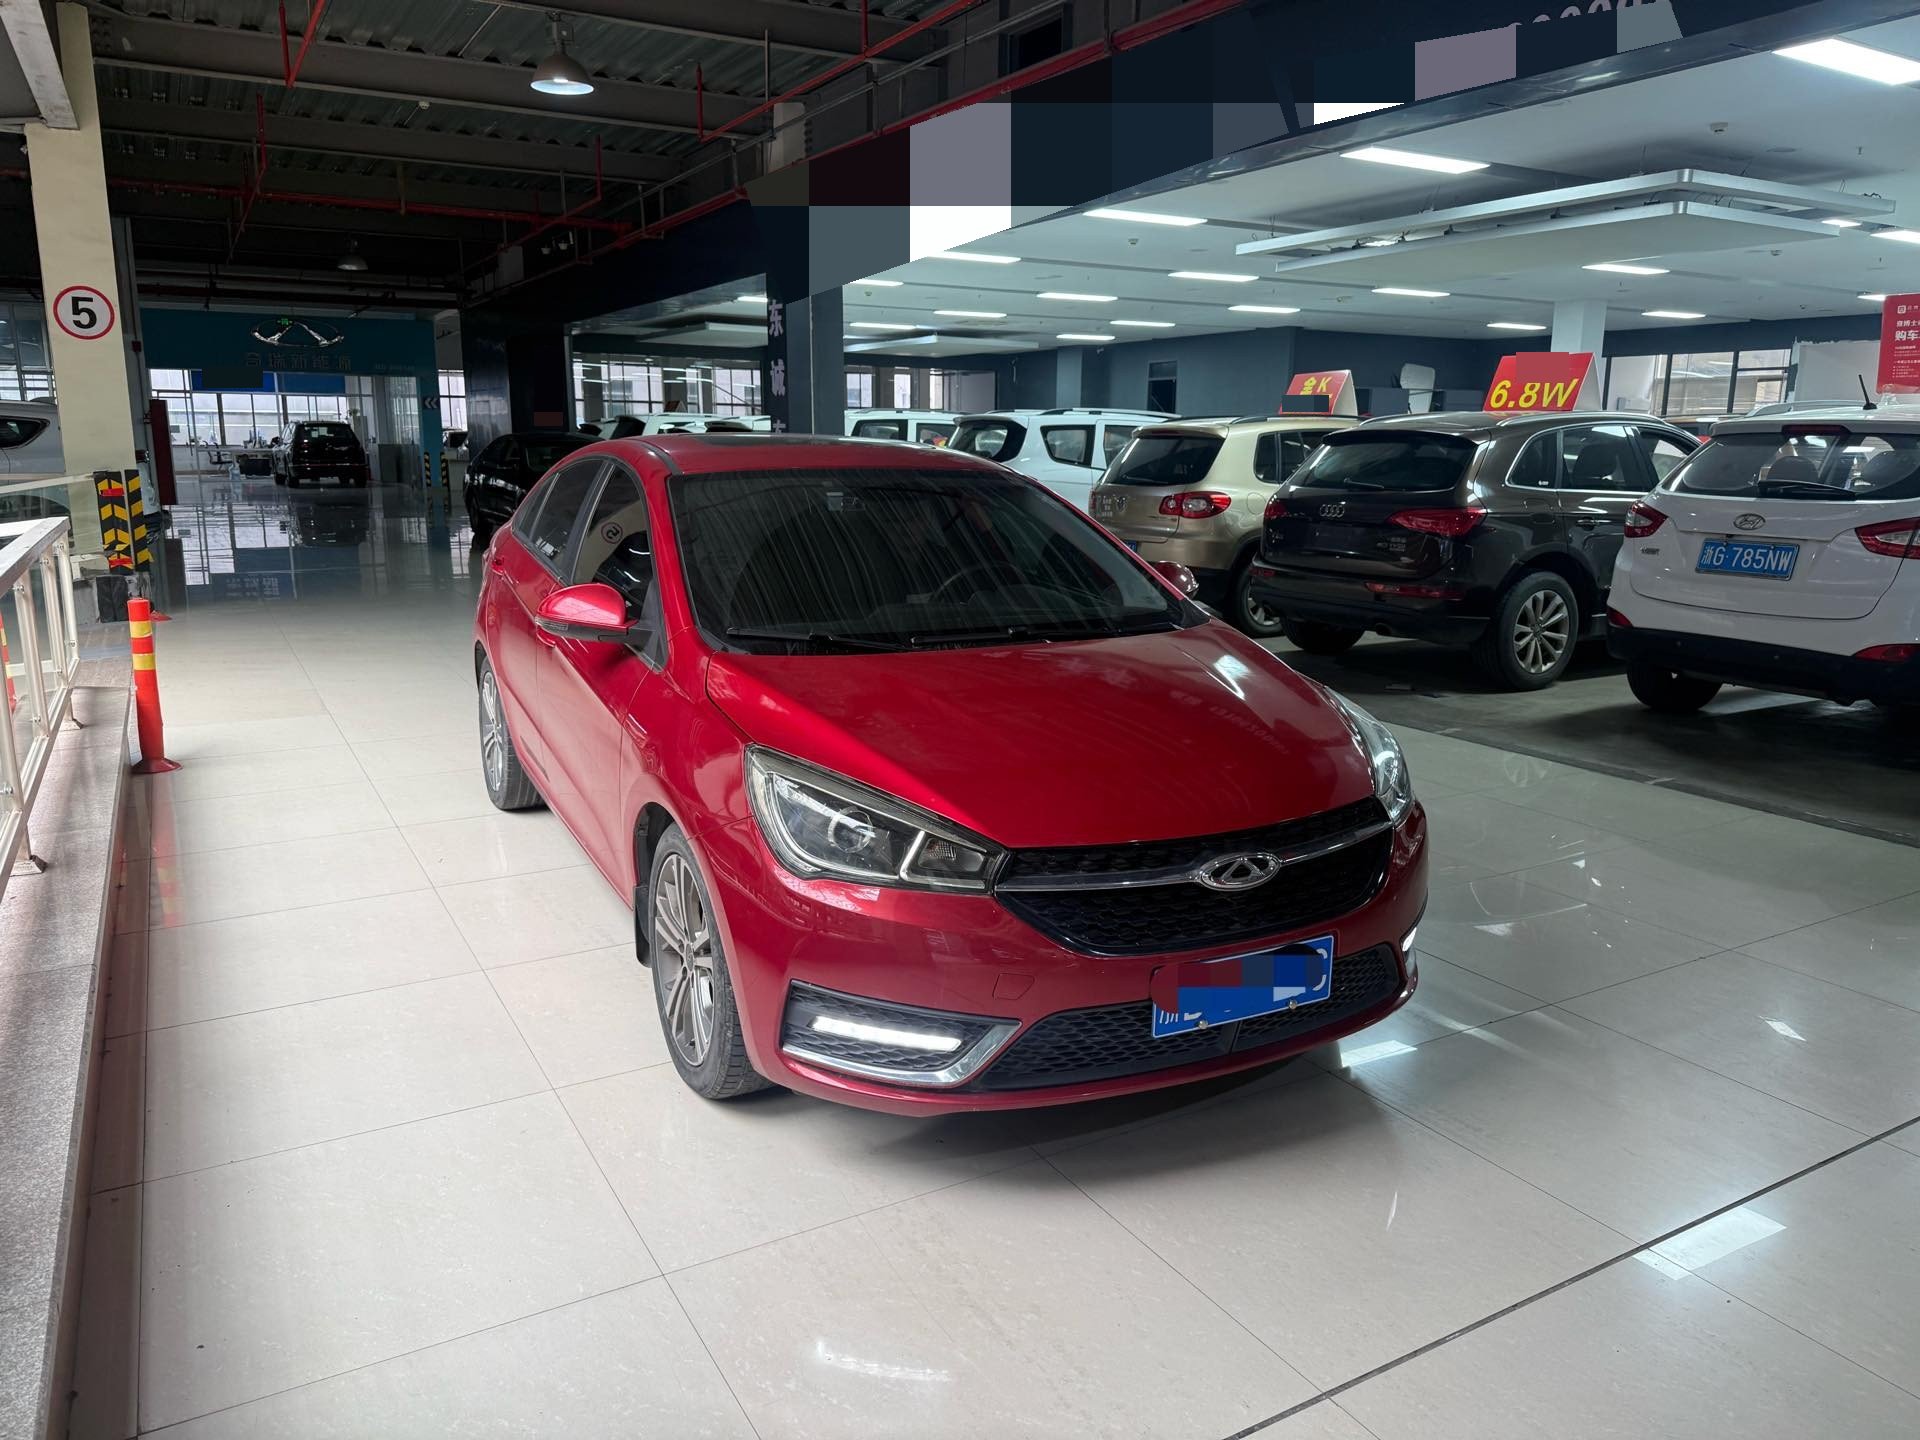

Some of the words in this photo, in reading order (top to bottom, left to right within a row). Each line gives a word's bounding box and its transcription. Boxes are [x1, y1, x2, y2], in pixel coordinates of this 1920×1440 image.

[72, 296, 97, 329] 5
[1894, 329, 1920, 342] 购车
[1490, 378, 1579, 408] 6.8W
